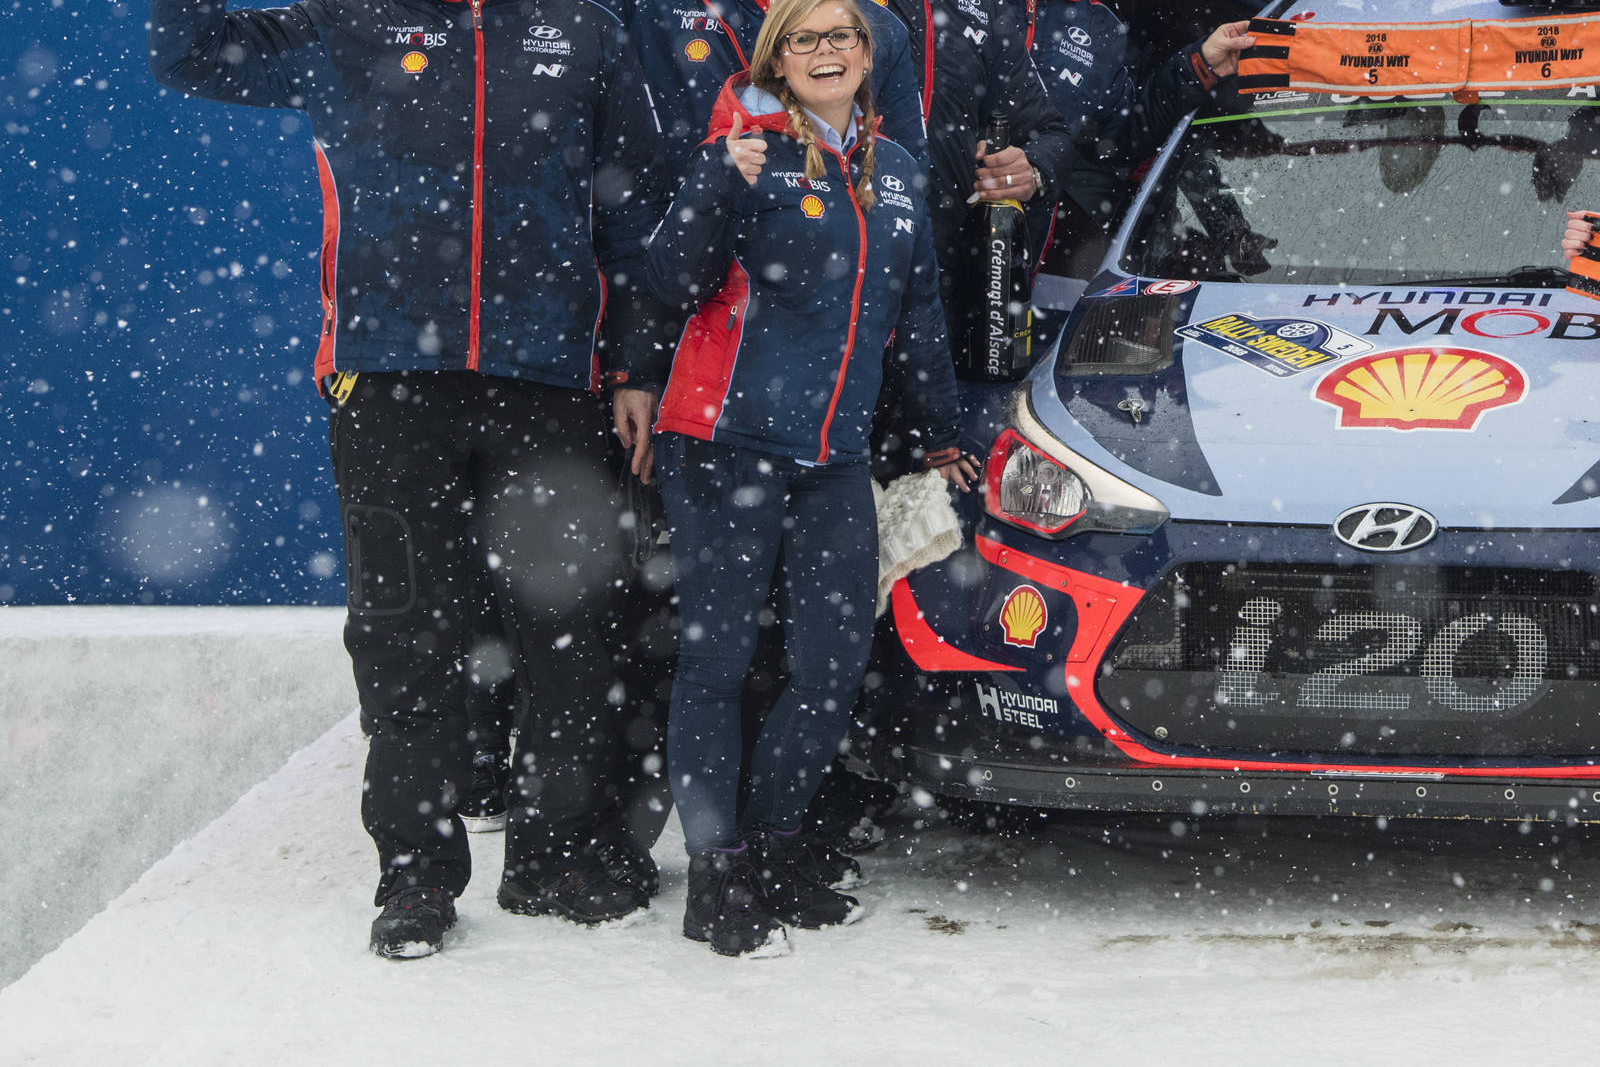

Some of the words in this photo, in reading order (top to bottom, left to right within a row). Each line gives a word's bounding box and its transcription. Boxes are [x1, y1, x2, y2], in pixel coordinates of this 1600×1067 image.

[673, 8, 707, 18] HYUNDAI
[387, 25, 424, 33] HYUNDAI
[1537, 27, 1560, 36] 2018
[395, 32, 447, 48] MOBIS
[522, 38, 571, 50] HYUNDAI
[1365, 33, 1387, 43] 2018
[523, 46, 572, 56] MOTORSPORT
[1059, 46, 1093, 68] MOTORSPORT
[1061, 38, 1094, 62] HYUNDAI
[1515, 50, 1559, 63] HYUNDAI
[1560, 48, 1584, 61] WRT
[1340, 55, 1385, 67] HYUNDAI
[1386, 55, 1410, 67] WRT
[1368, 69, 1378, 84] 5
[1541, 63, 1551, 78] 6
[784, 177, 831, 193] MOBIS
[880, 190, 913, 205] HYUNDAI
[1303, 291, 1554, 308] HYUNDAI
[1201, 315, 1266, 340] RALLY
[1247, 334, 1332, 368] SWEDEN
[1218, 596, 1548, 712] i20
[999, 690, 1058, 714] HYUNDAI
[1003, 708, 1043, 729] STEEL
